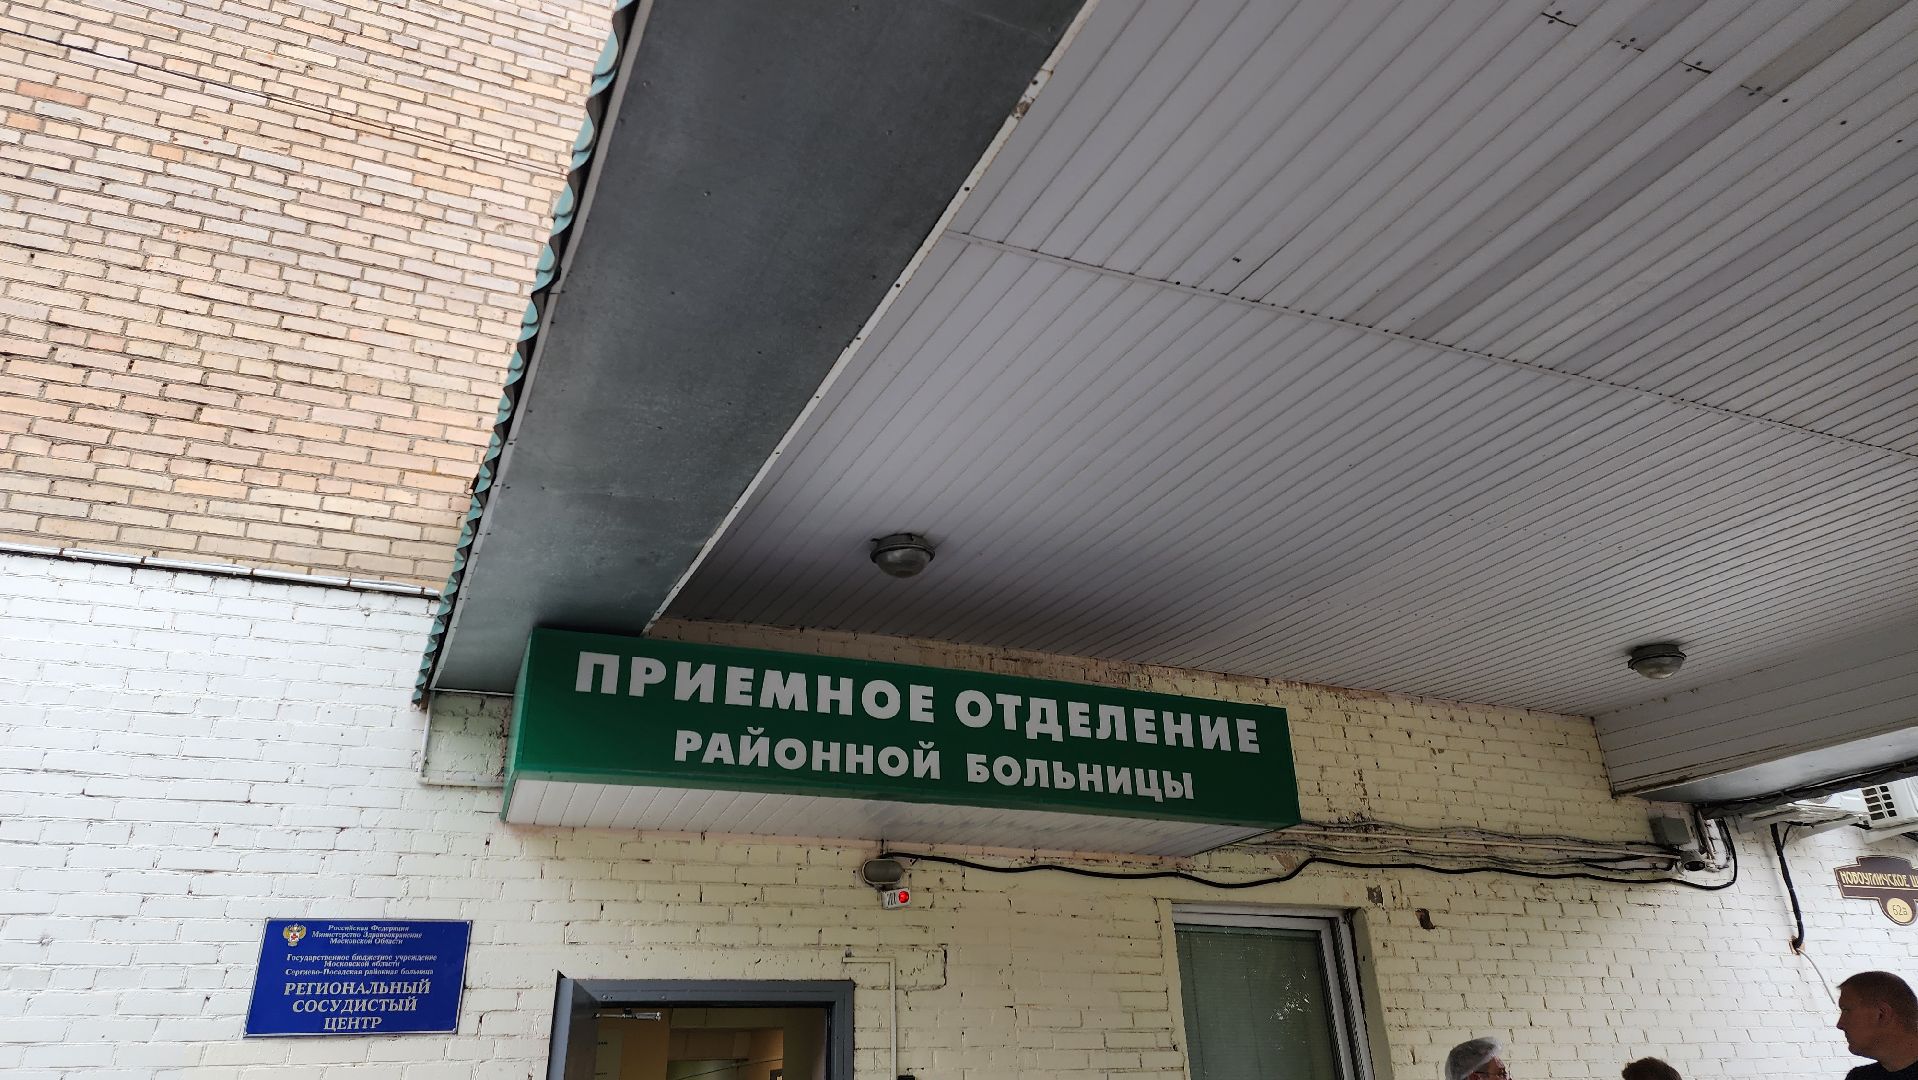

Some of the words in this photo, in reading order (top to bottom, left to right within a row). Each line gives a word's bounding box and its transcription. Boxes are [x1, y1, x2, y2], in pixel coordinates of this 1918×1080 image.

[575, 651, 935, 723] ПРИЕМНОЕ
[954, 689, 1261, 754] ОТДЕЛЕНИЕ
[674, 727, 941, 780] РАЙОННОЙ
[966, 752, 1194, 803] БОЛЬНИЦЫ
[1840, 871, 1910, 887] НОВОУГЛИЧСКОЕ
[312, 931, 361, 939] Министерство
[329, 937, 373, 945] Московской
[374, 937, 403, 945] Области
[287, 954, 350, 962] Государственное
[352, 953, 393, 962] бюджетное
[285, 968, 362, 976] Сергиево-Посадская
[364, 969, 398, 977] районная
[400, 968, 434, 976] больница
[284, 979, 431, 996] РЕГИОНАЛЬНЫЙ
[293, 996, 418, 1014] СОСУДИСТЫЙ
[323, 1017, 382, 1032] ЦЕНТР
